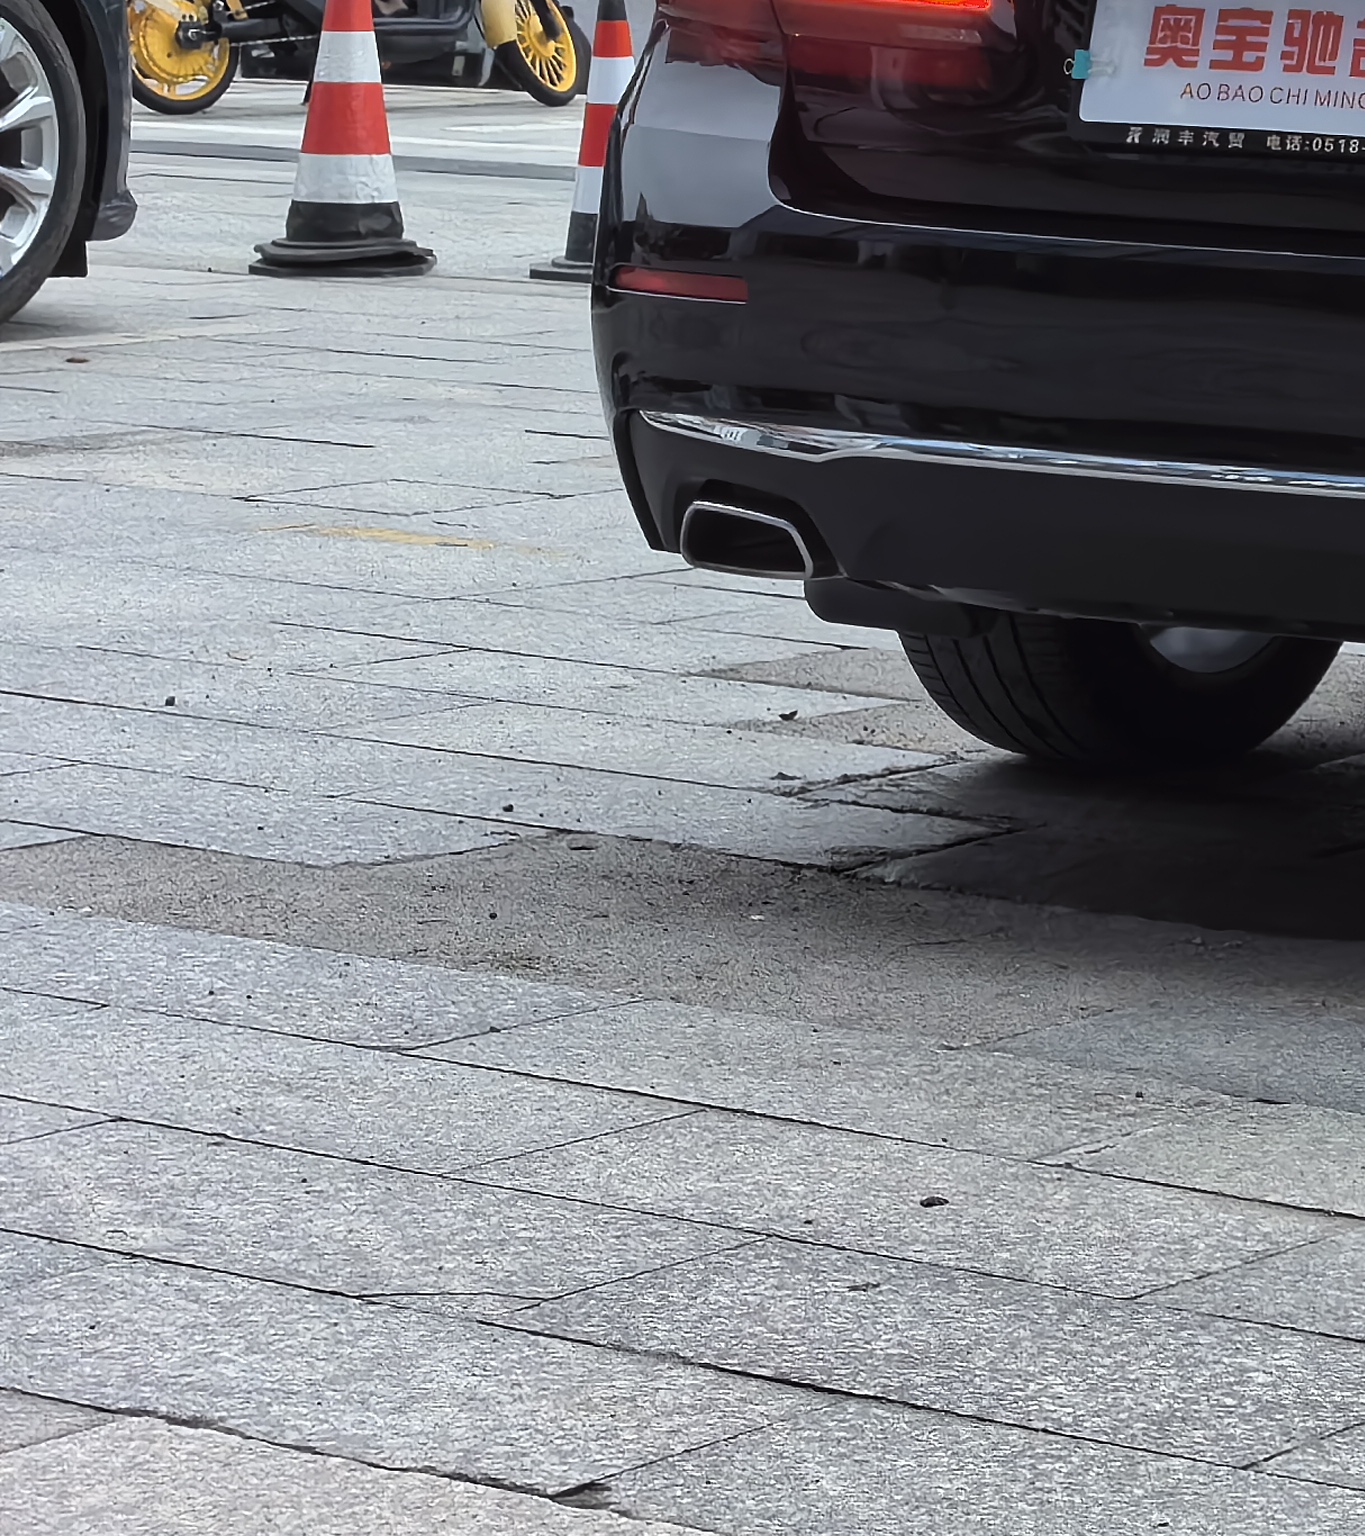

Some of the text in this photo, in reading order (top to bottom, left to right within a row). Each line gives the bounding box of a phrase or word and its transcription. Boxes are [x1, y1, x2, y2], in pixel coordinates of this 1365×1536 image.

[1180, 81, 1212, 101] AO
[1217, 83, 1264, 103] BAO
[1269, 86, 1309, 106] CHI
